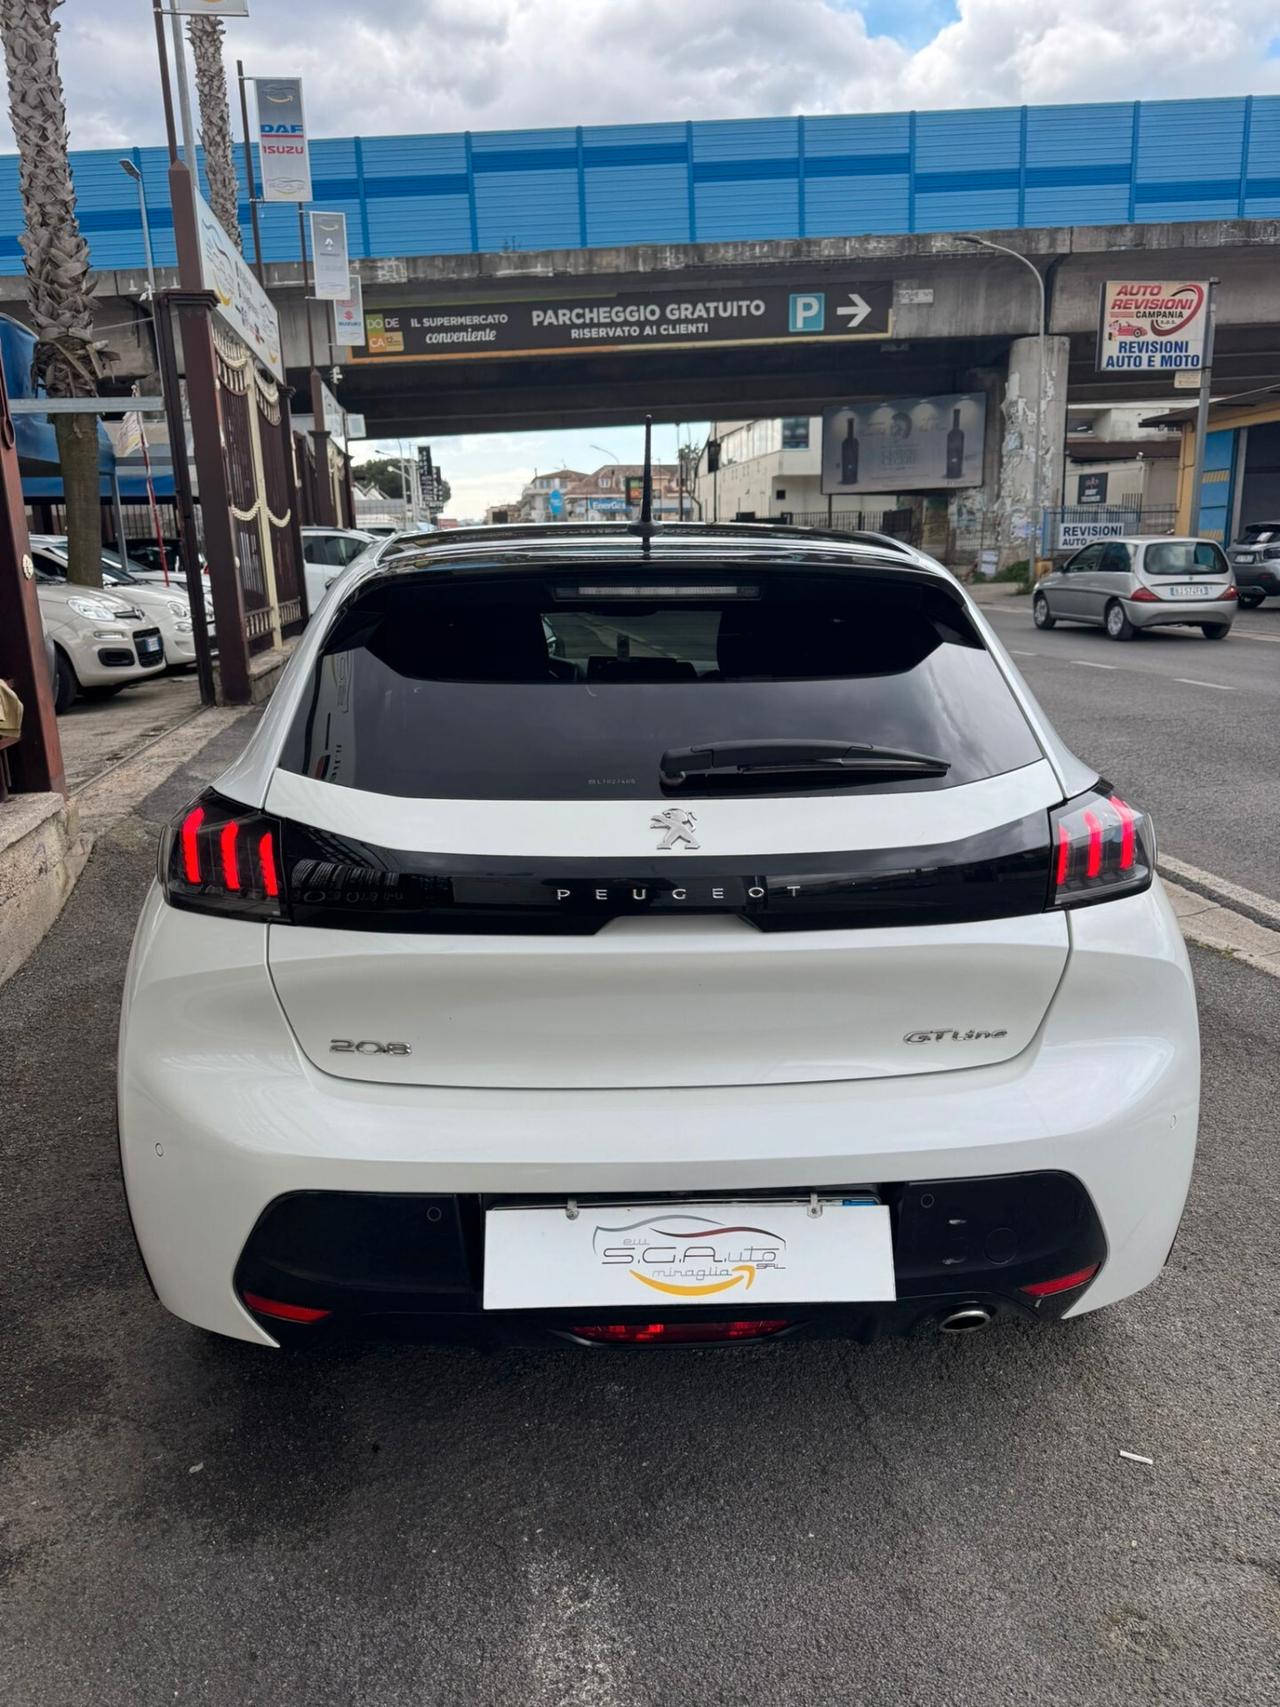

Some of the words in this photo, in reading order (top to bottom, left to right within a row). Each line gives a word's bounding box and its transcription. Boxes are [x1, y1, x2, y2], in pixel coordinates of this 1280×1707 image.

[260, 124, 304, 133] DAF
[263, 145, 304, 154] ISUZU
[1117, 285, 1161, 296] AUTO
[1112, 298, 1193, 310] REVISIONI
[532, 304, 660, 326] PARCHEGGIO
[665, 299, 765, 320] GRATUITO
[796, 297, 819, 328] P
[1135, 311, 1184, 319] CAMPANIA
[411, 318, 421, 328] IL
[423, 314, 508, 327] SUPERMERCATO
[426, 328, 497, 344] conveniente
[571, 326, 640, 339] RISERVATO
[643, 325, 657, 336] AI
[660, 323, 709, 335] CLIENTI
[1118, 341, 1189, 354] REVISIONI
[1106, 355, 1142, 368] AUTO
[1147, 355, 1156, 367] E
[1160, 354, 1200, 367] MOTO
[1063, 526, 1122, 537] REVISIONI
[1062, 538, 1087, 547] AUTO
[556, 885, 801, 901] PEUGEOT
[330, 1039, 412, 1056] 208
[652, 1267, 734, 1281] miraglia
